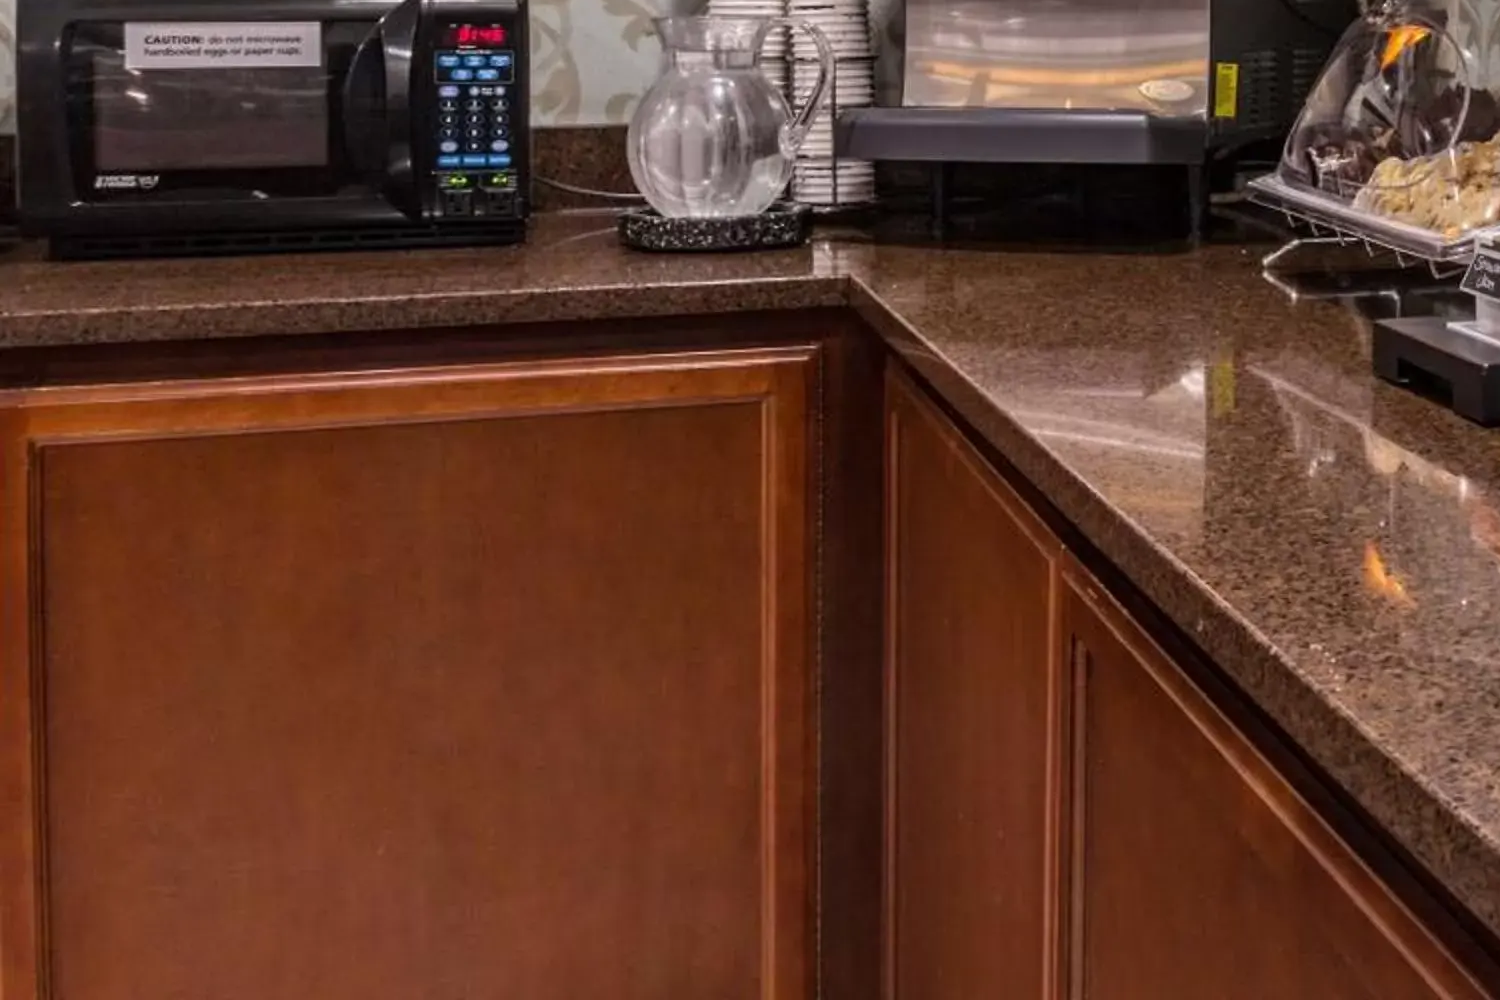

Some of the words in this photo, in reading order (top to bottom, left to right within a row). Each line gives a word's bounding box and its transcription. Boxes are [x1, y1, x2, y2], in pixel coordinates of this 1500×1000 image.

[144, 35, 205, 46] CAUTION:
[208, 35, 223, 45] do
[225, 35, 243, 45] not
